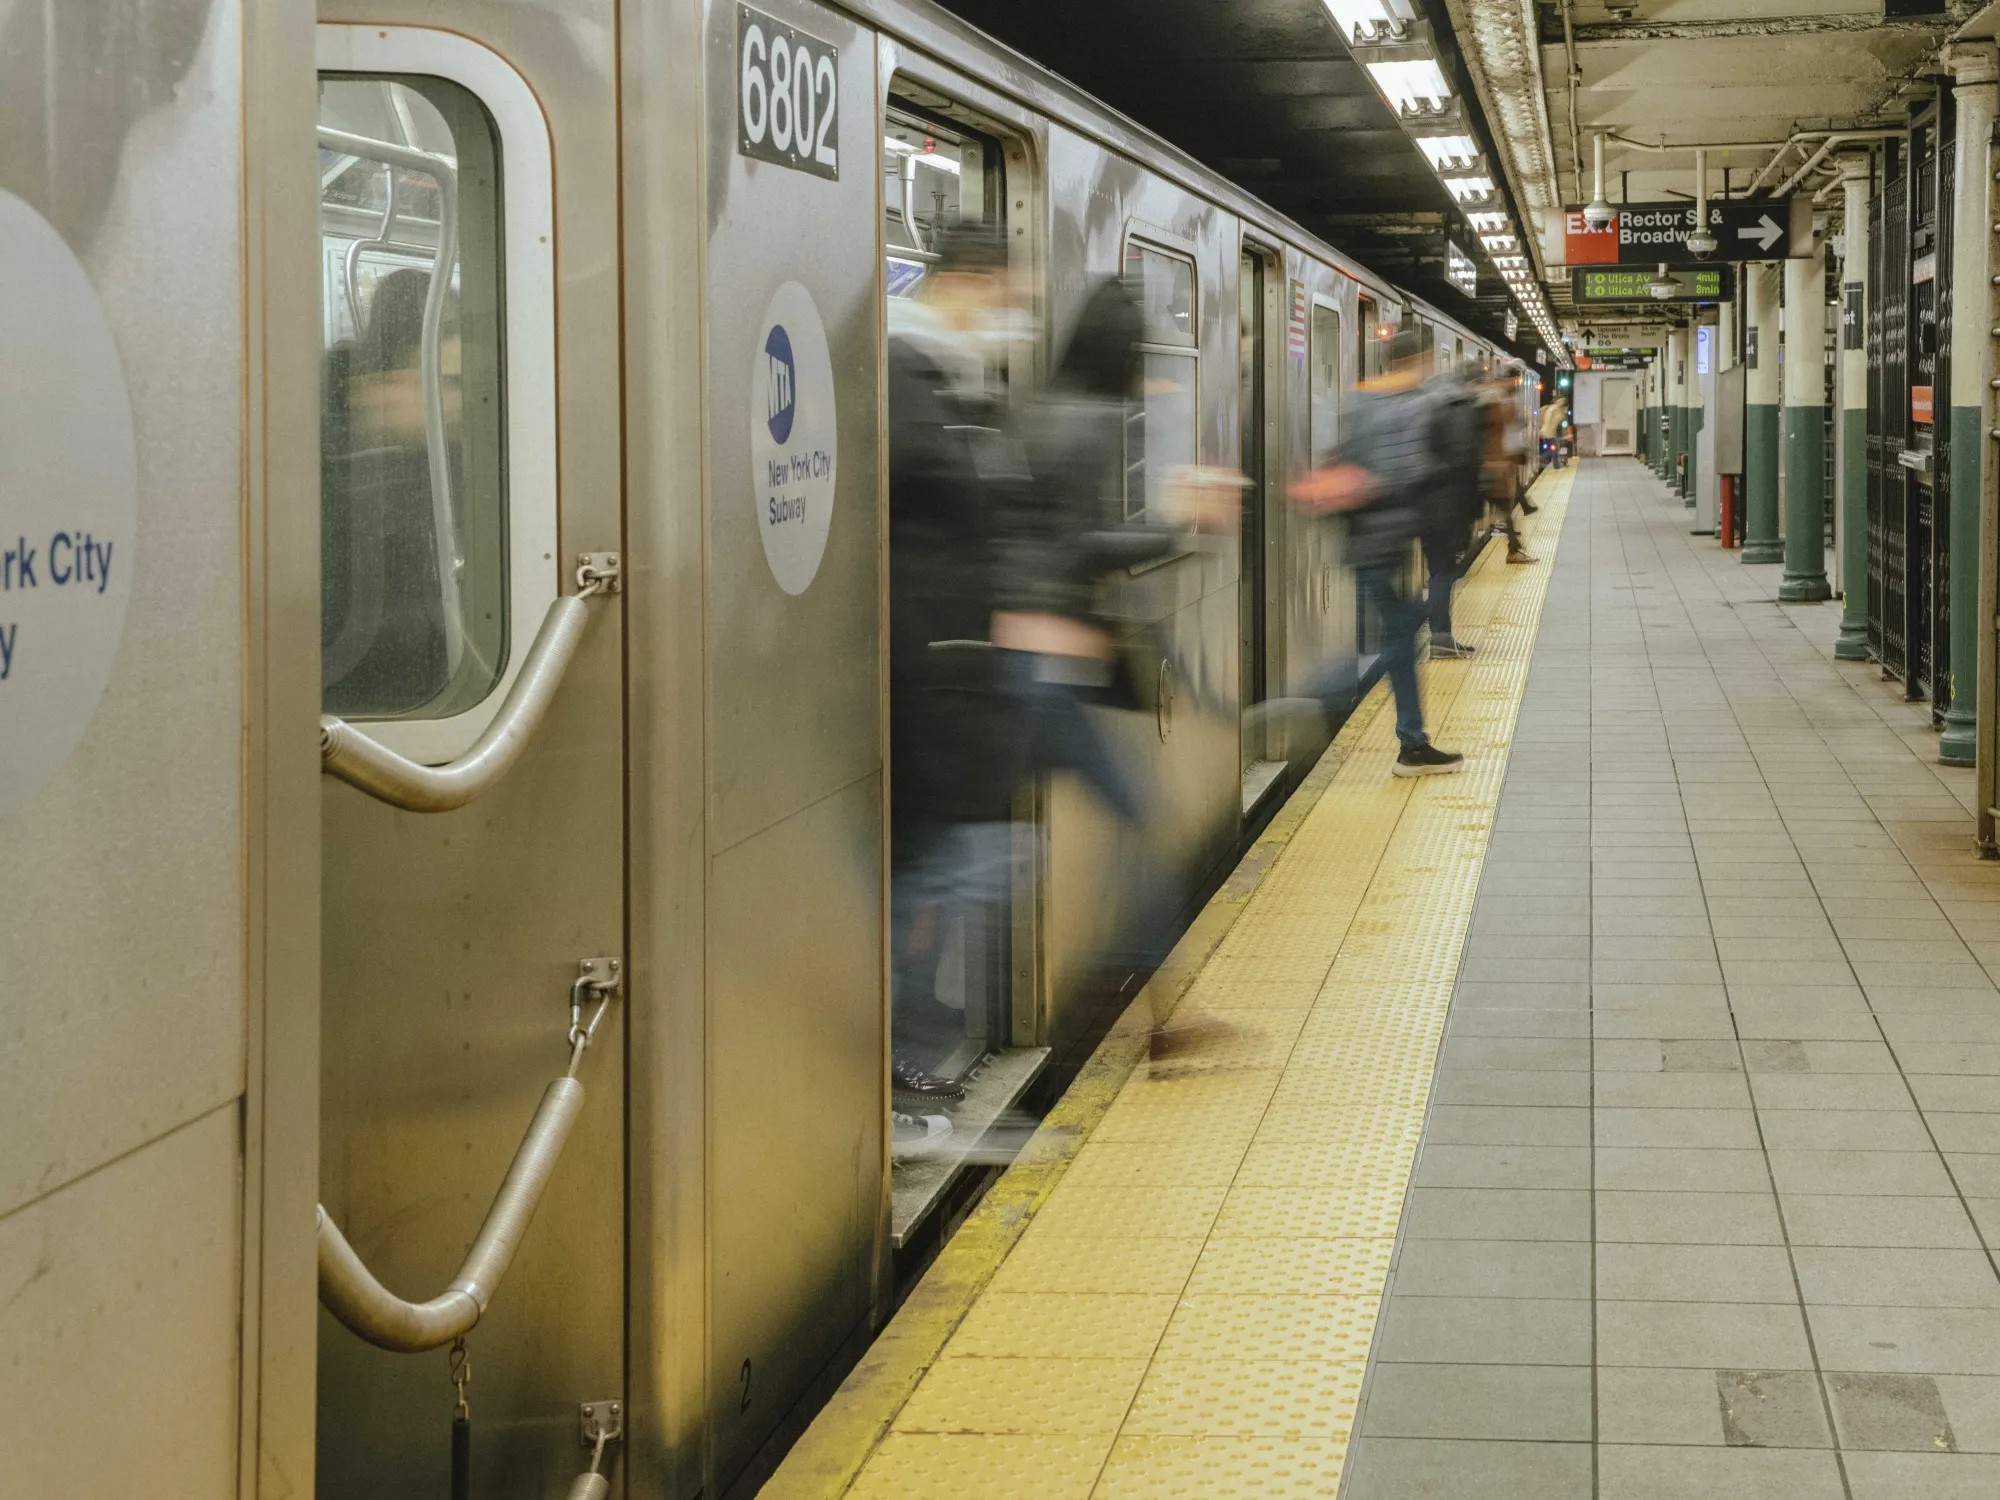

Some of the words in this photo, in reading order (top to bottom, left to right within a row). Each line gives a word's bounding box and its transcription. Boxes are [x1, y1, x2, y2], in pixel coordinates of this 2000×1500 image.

[742, 24, 836, 167] 6802
[1567, 213, 1612, 234] Ext
[1619, 211, 1681, 227] Rector
[1710, 209, 1723, 224] &
[1619, 228, 1711, 244] Broadw
[1608, 273, 1632, 283] Utica
[1636, 273, 1650, 283] Av
[1697, 272, 1719, 282] 4min
[1608, 285, 1632, 295] Utica
[768, 355, 792, 420] MTA
[768, 460, 789, 488] New
[791, 453, 811, 482] York
[813, 450, 831, 482] City
[769, 496, 806, 525] Subway
[0, 536, 37, 591] rk
[49, 531, 113, 594] City
[740, 1357, 751, 1415] 2
